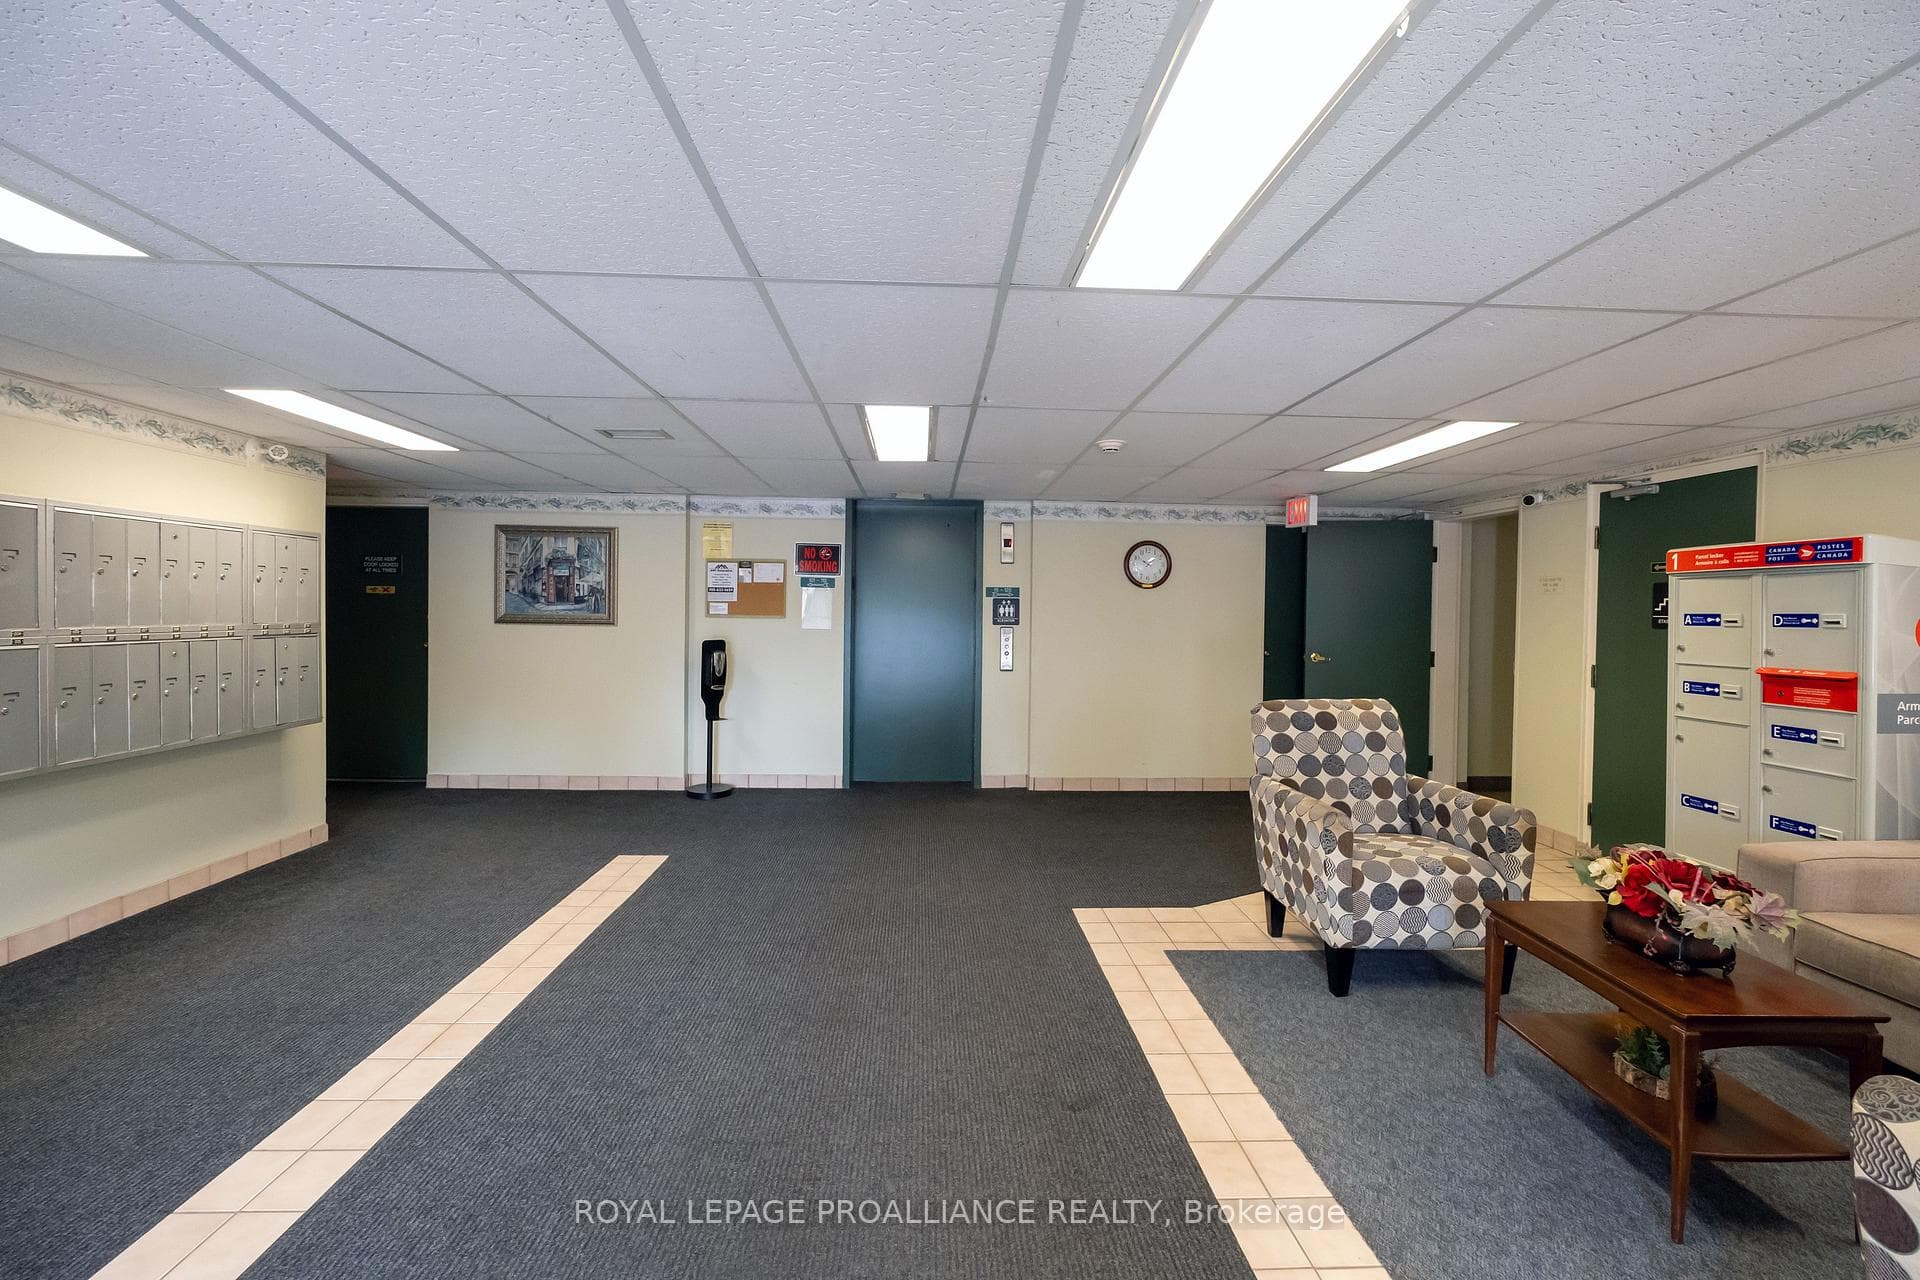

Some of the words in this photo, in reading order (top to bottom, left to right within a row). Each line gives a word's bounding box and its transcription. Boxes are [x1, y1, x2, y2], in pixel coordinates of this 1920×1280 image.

[804, 546, 816, 559] NO
[799, 560, 837, 572] SMOKING
[1671, 553, 1678, 571] 1
[1684, 615, 1692, 625] A
[1773, 615, 1783, 626] D
[1684, 682, 1690, 692] B
[1773, 726, 1781, 737] E
[1682, 795, 1690, 806] C
[1772, 817, 1780, 828] F
